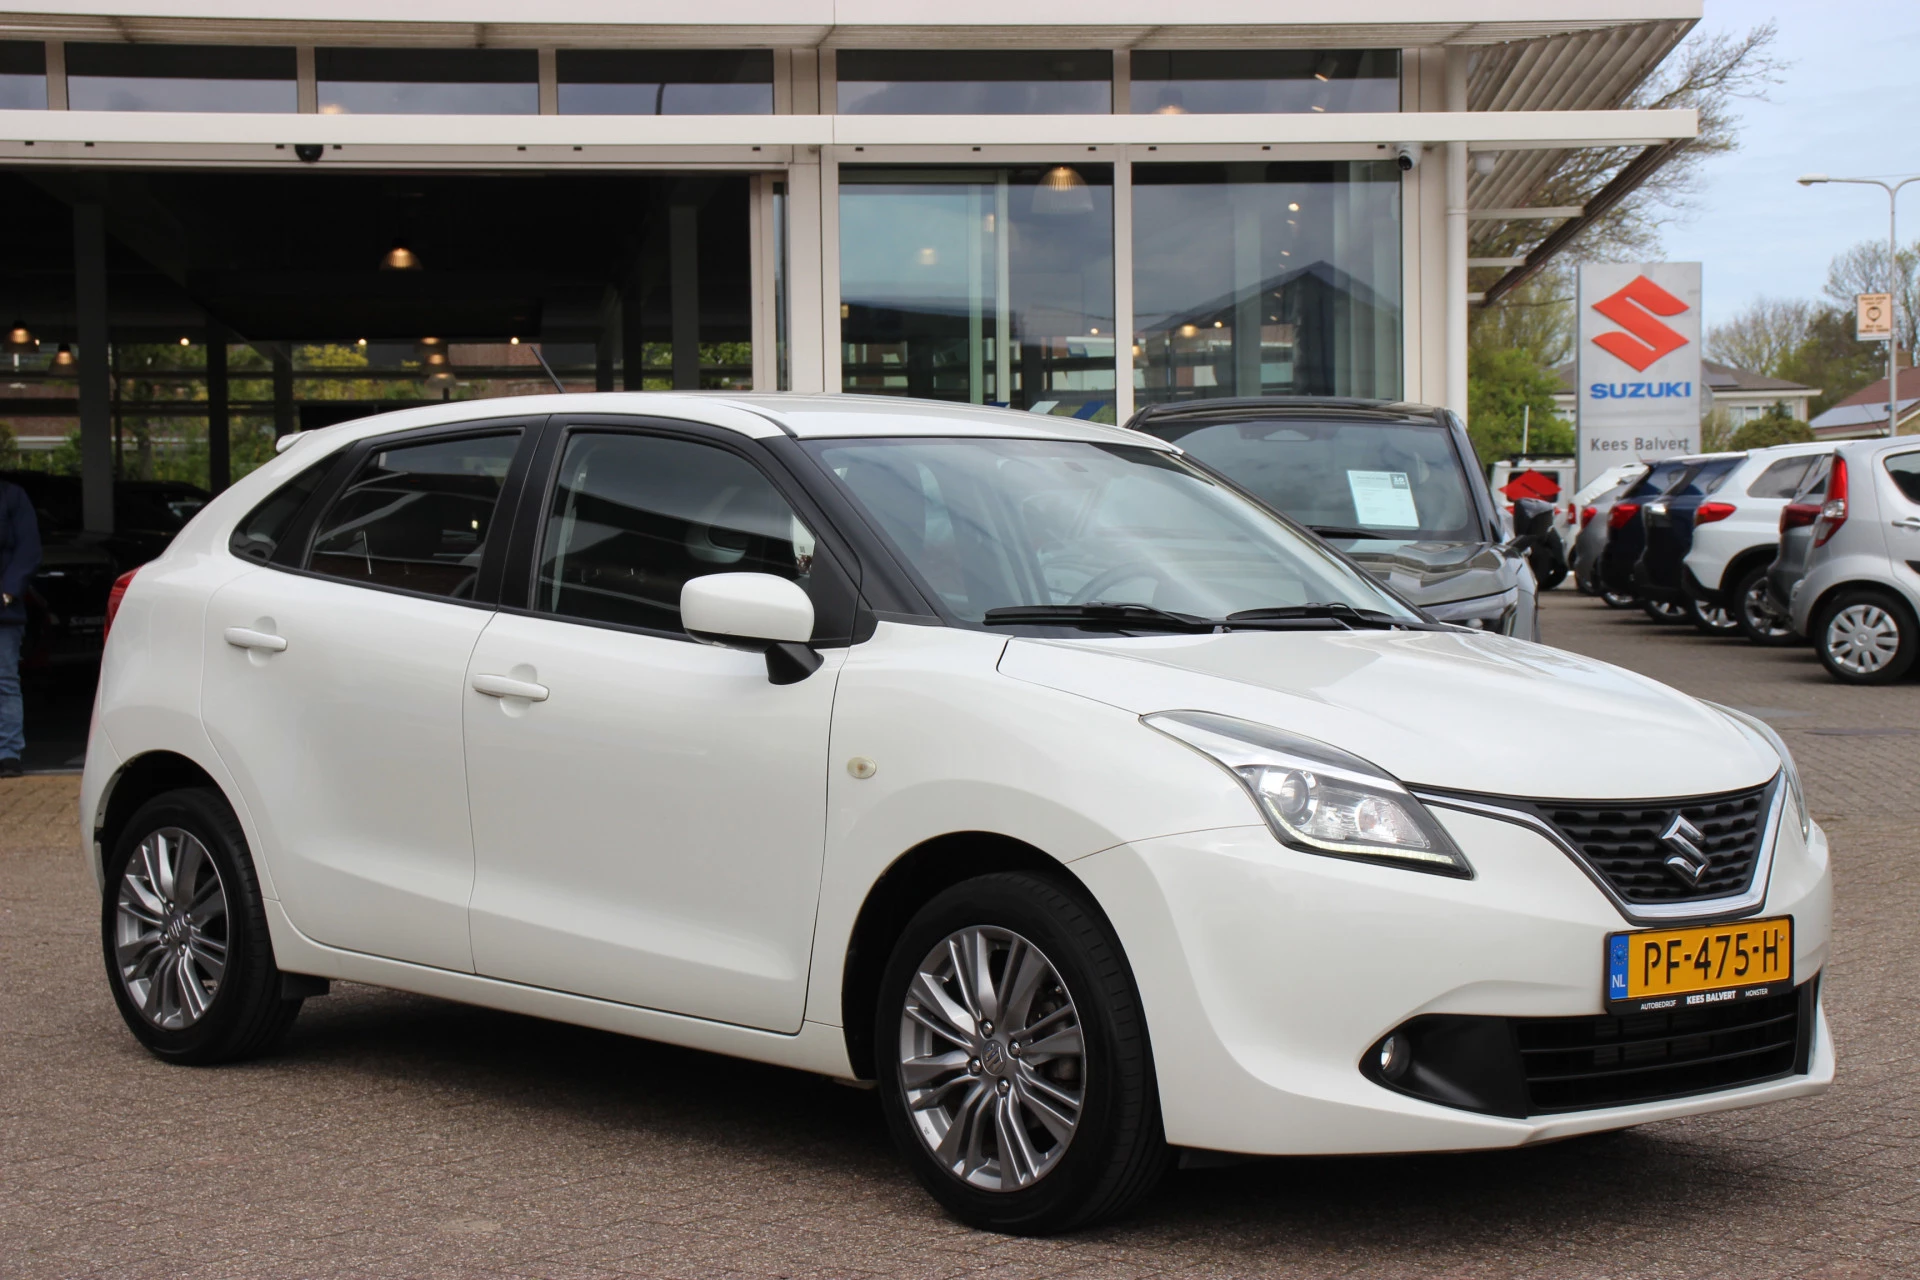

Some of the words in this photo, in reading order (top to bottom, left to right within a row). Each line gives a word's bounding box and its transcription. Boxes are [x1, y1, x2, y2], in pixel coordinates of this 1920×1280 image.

[1590, 382, 1692, 399] SUZUKI
[1591, 438, 1628, 451] Kees
[1634, 437, 1690, 451] Balvert
[1644, 929, 1779, 986] PF-475-H
[1612, 974, 1626, 988] NL
[1686, 994, 1705, 1006] KEES
[1705, 990, 1737, 1004] BALVERT
[1745, 987, 1768, 997] MONSTER
